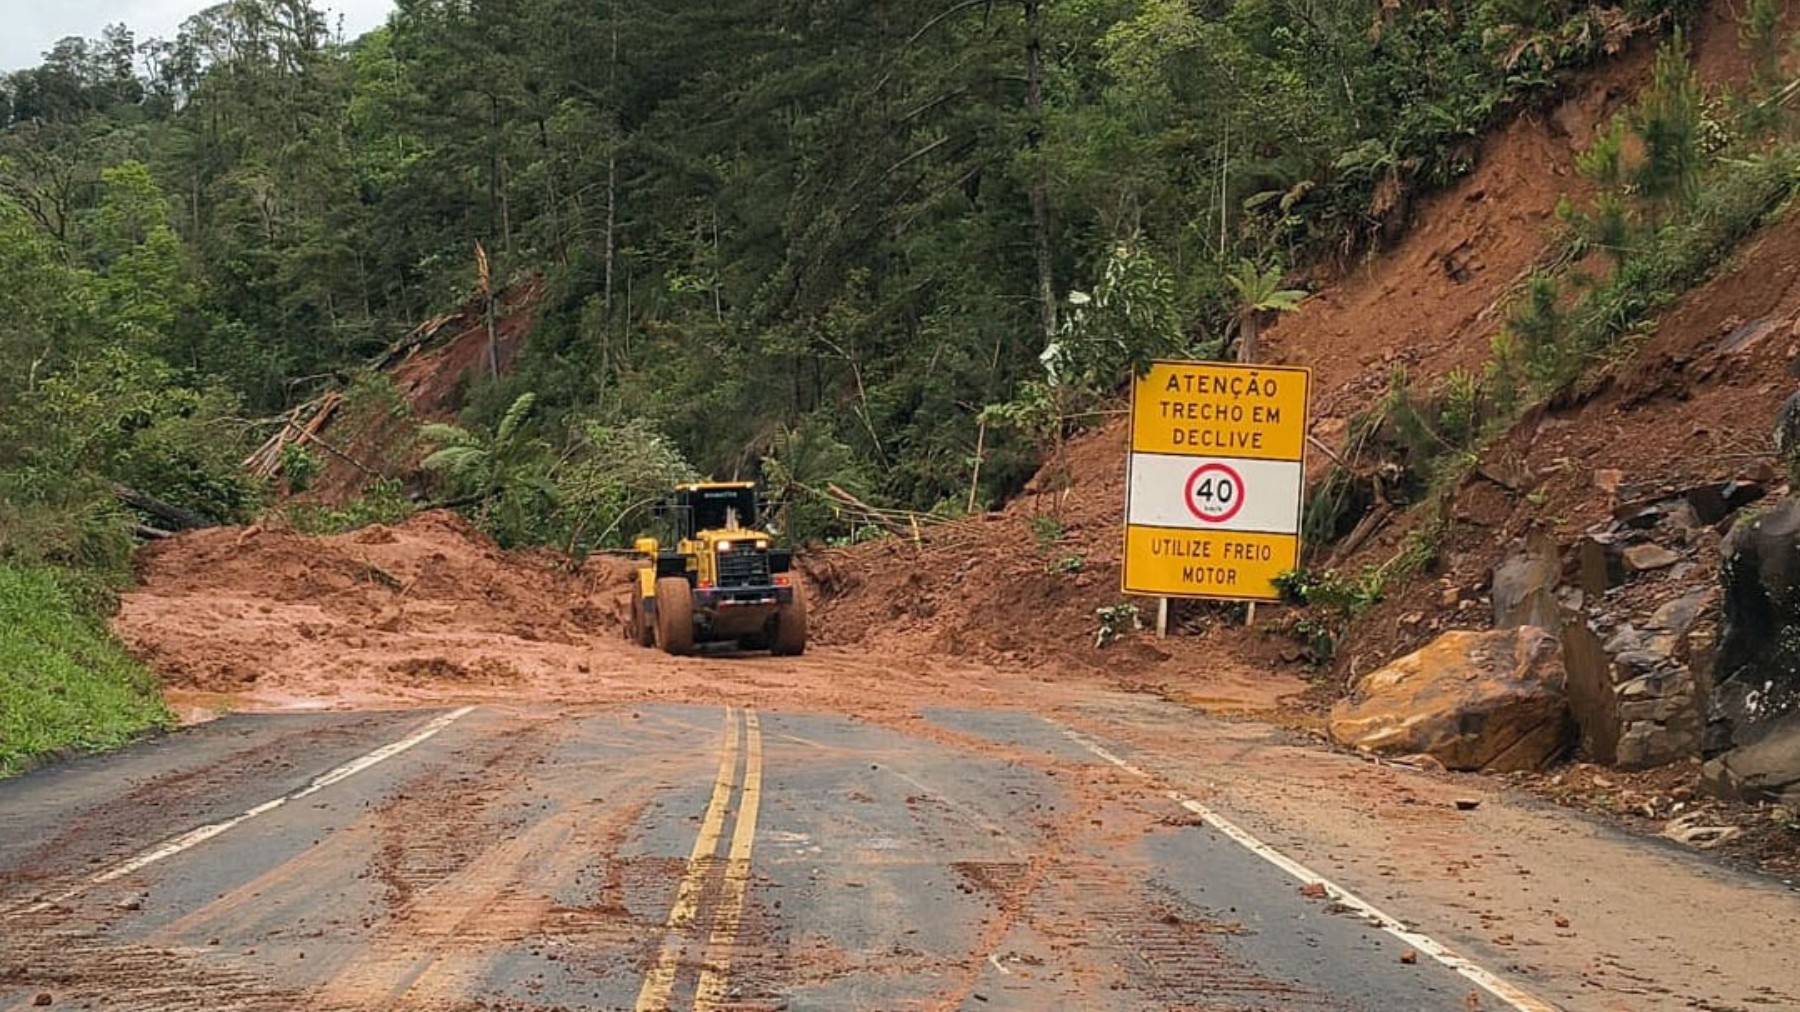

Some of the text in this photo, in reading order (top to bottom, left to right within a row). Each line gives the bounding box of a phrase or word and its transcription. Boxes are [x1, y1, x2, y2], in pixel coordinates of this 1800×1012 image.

[1165, 372, 1278, 399] ATENÇÃO
[1160, 401, 1280, 423] TRECHO EM
[1172, 428, 1263, 449] DECLIVE
[1196, 478, 1233, 503] 40
[1152, 538, 1271, 561] UTILIZE FREIO
[1182, 567, 1237, 584] MOTOR
